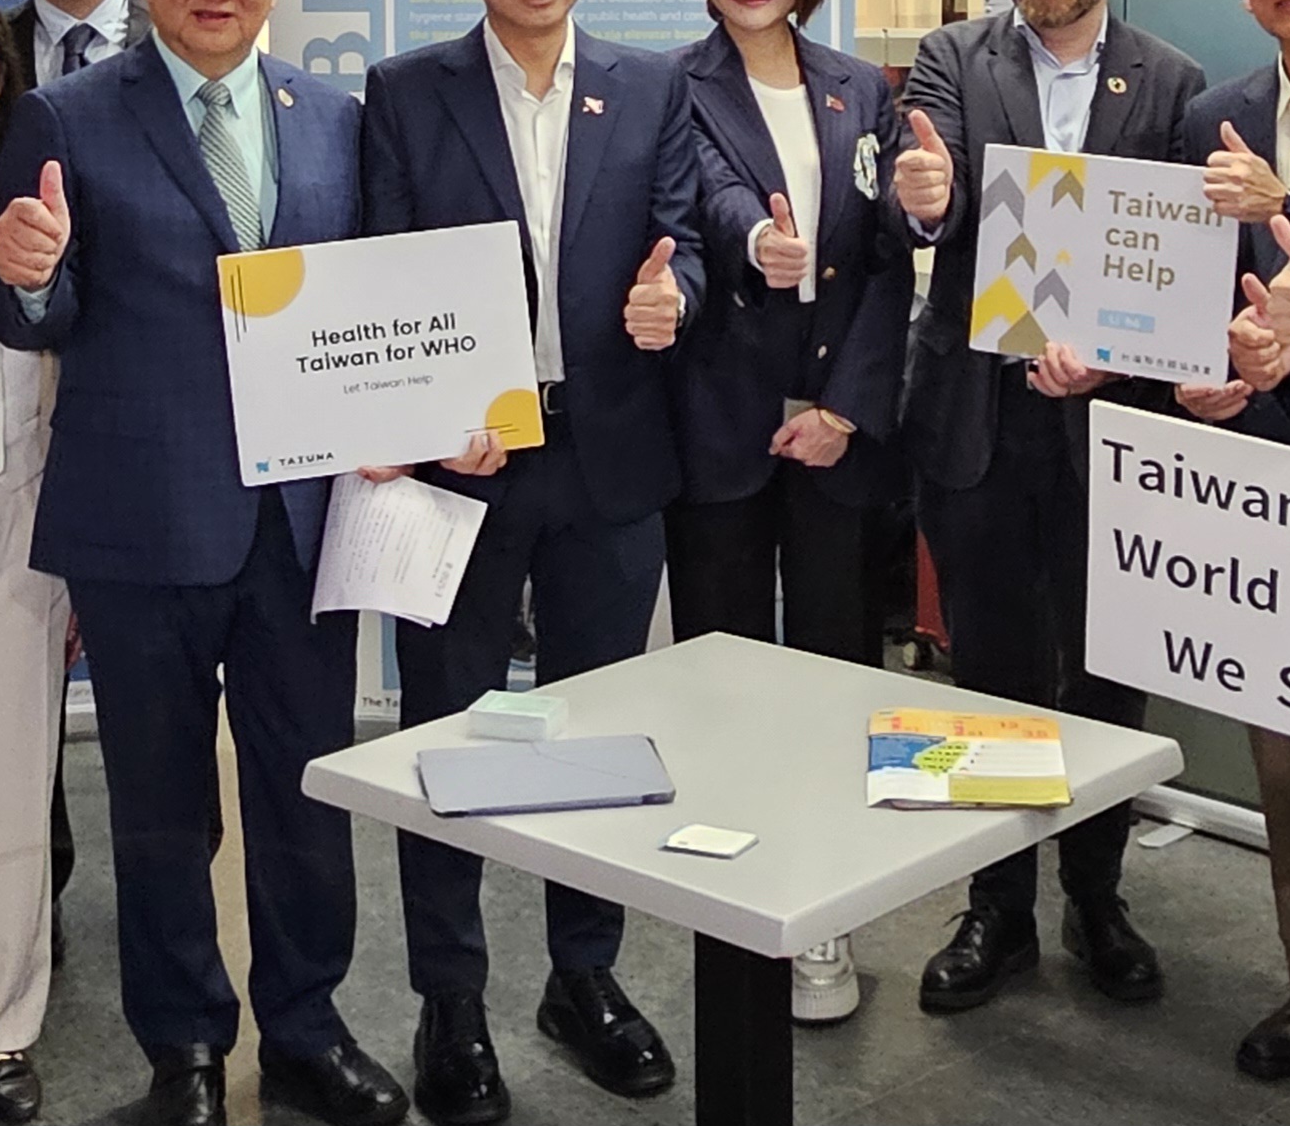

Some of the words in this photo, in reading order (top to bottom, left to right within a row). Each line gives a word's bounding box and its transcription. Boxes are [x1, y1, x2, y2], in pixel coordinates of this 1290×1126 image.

[1108, 190, 1223, 228] Taiwan
[1105, 227, 1160, 252] can
[1103, 254, 1176, 292] Help
[312, 322, 386, 347] Health
[393, 319, 421, 336] for
[429, 312, 456, 332] All
[296, 350, 380, 373] Taiwan
[385, 344, 415, 362] for
[421, 335, 476, 357] WHO
[343, 384, 360, 394] Let
[364, 377, 406, 391] Taiwan
[408, 374, 434, 386] Help
[1112, 527, 1280, 615] World
[1163, 629, 1247, 693] We
[362, 697, 382, 708] The
